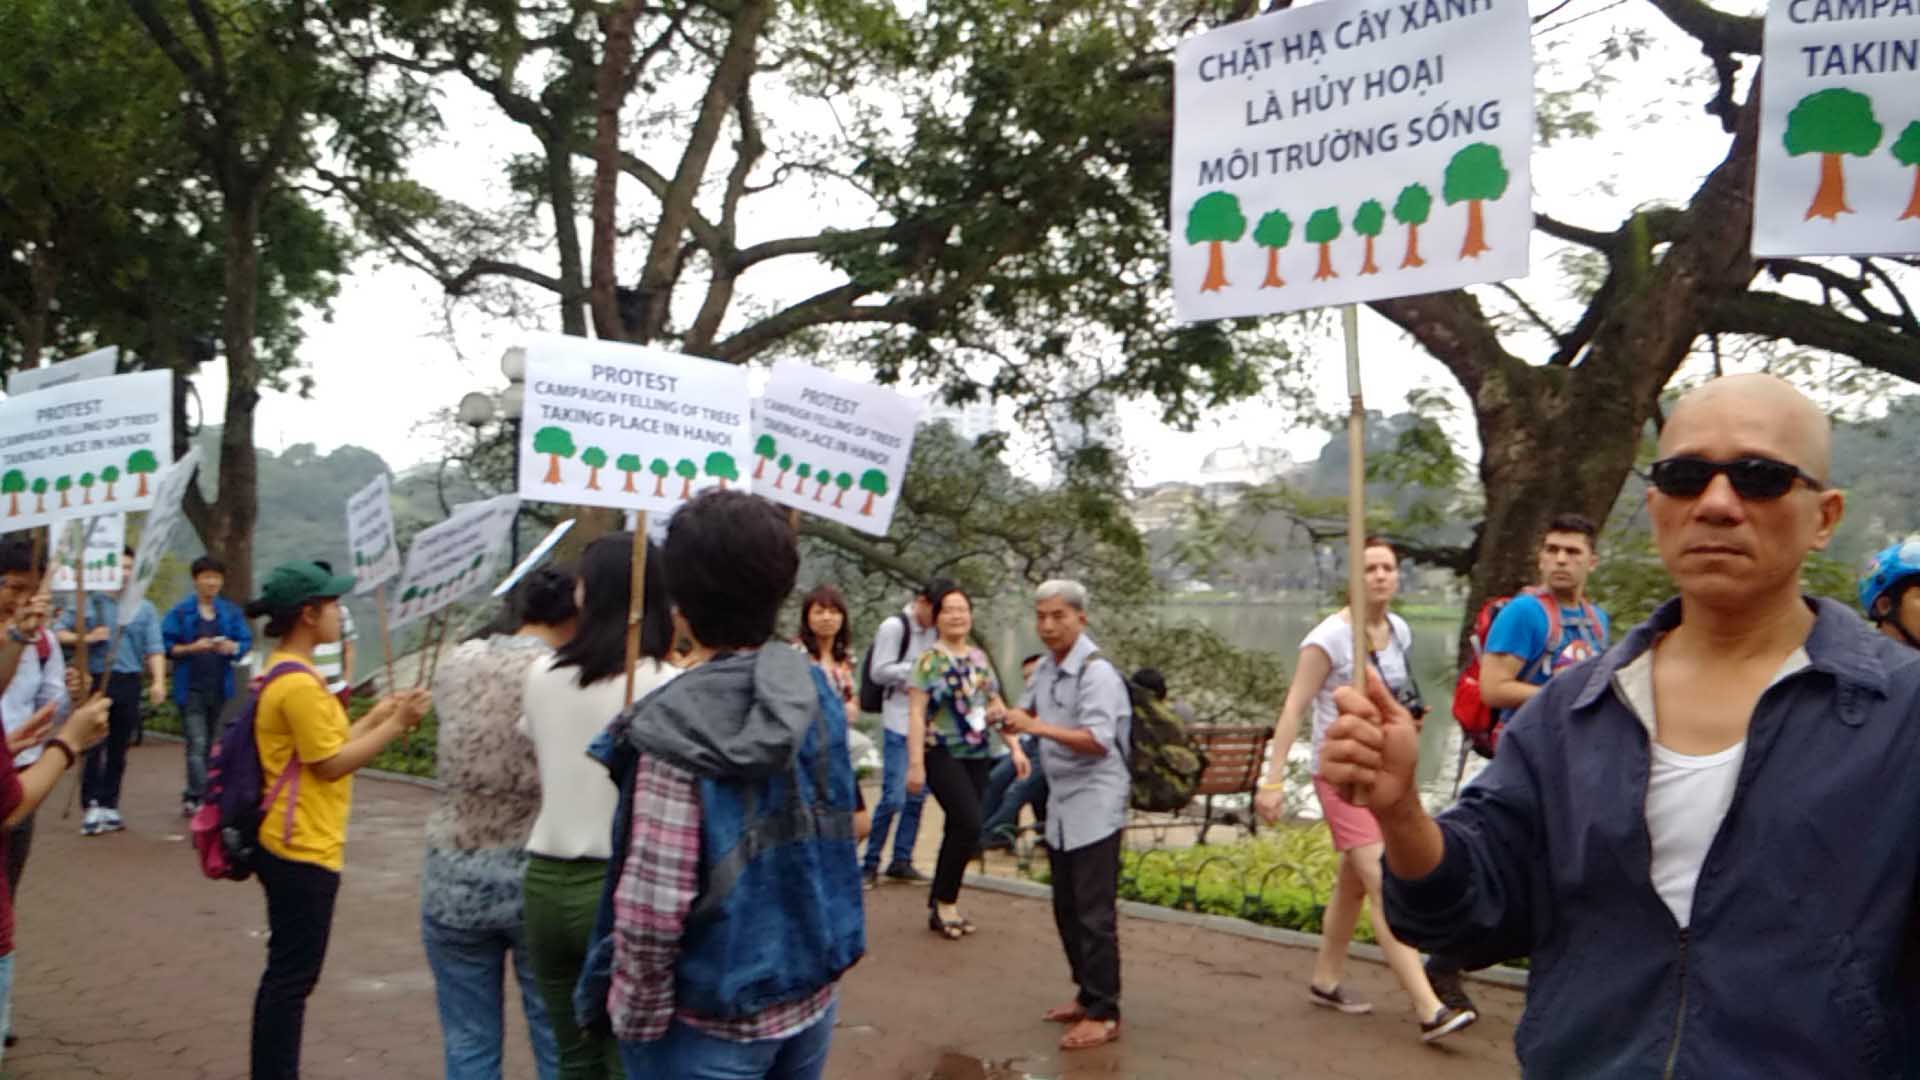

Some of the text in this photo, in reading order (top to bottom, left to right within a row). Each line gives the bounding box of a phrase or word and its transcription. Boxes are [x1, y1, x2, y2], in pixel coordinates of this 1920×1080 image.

[1199, 39, 1274, 82] CHẶT
[1282, 28, 1327, 65] HẠ
[1335, 9, 1391, 50] CÂY
[1801, 38, 1920, 77] TAKIN
[1246, 54, 1443, 126] LÀ HỦY HOẠI
[1198, 99, 1501, 187] MÔI TRƯỜNG SỐNG
[592, 364, 678, 393] PROTEST
[36, 399, 103, 423] PROTEST
[534, 380, 617, 404] CAMPAIGN
[620, 393, 678, 415] FELLING
[681, 403, 699, 417] OF
[701, 407, 741, 427] TREES
[800, 387, 860, 415] PROTEST
[541, 404, 733, 447] TAKING PLACE IN HANOI
